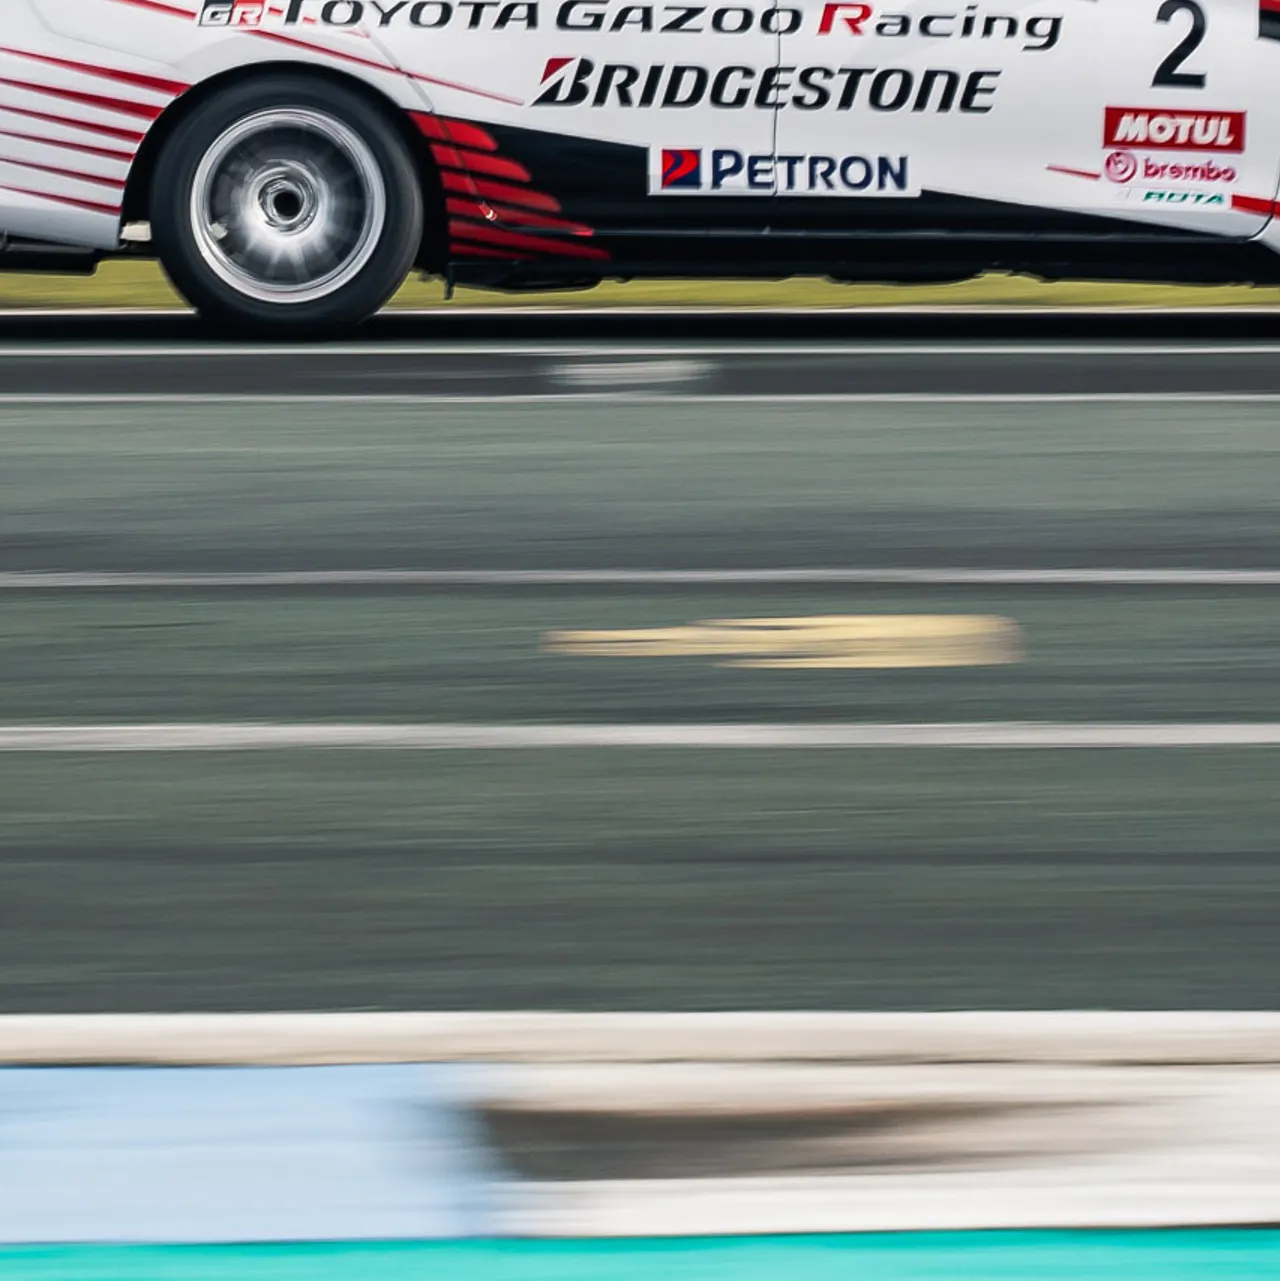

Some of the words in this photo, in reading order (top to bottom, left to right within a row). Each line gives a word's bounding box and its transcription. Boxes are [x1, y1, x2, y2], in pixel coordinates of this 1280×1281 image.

[200, 0, 265, 27] GR
[817, 2, 1064, 52] Racing
[529, 57, 1002, 114] BRIDGESTONE
[1112, 112, 1236, 147] MOTUL
[711, 149, 909, 191] PETRON
[1143, 157, 1237, 183] brembo
